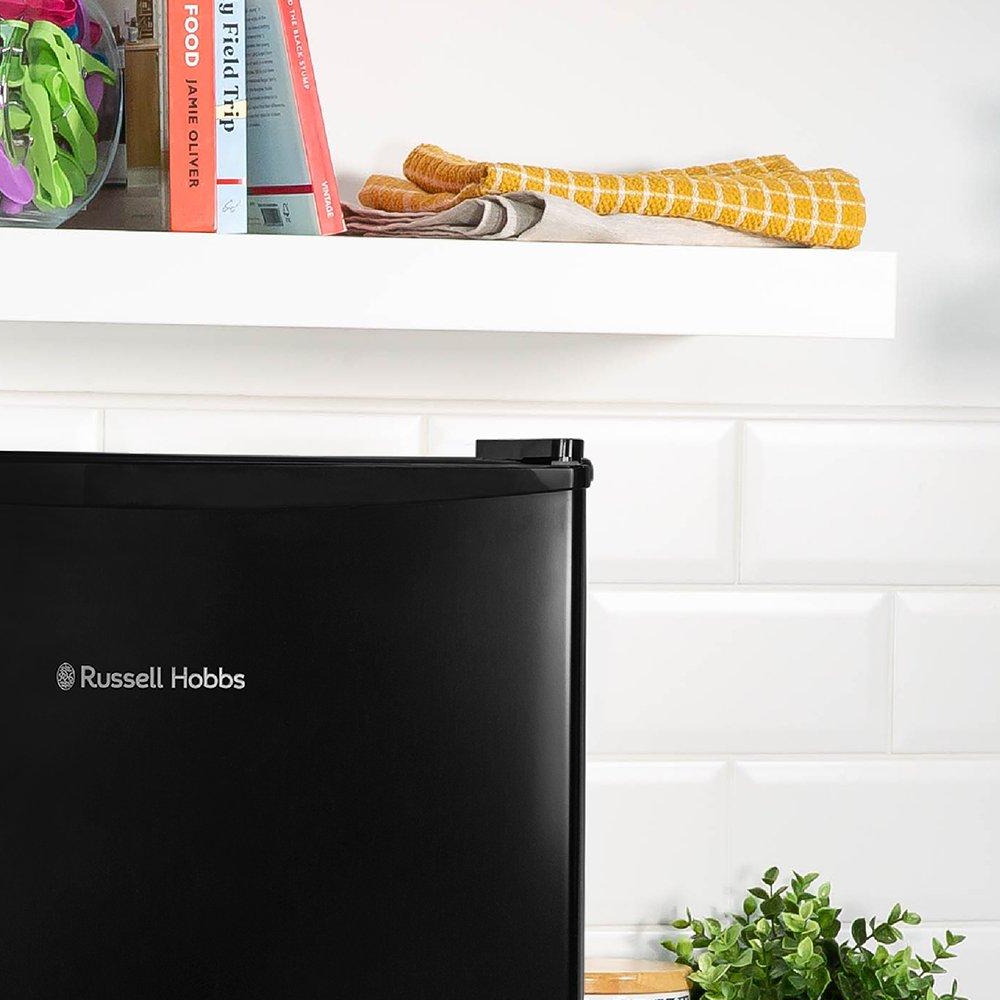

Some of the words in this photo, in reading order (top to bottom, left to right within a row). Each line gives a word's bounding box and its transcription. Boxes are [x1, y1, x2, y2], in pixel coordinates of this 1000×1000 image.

[184, 4, 199, 67] FOOD
[290, 9, 298, 26] THE
[223, 23, 239, 78] Field
[293, 29, 304, 58] BLACK
[298, 60, 310, 90] STUMP
[186, 79, 198, 124] JAMIE
[219, 85, 239, 132] Trip
[188, 130, 199, 188] OLIVER
[322, 181, 335, 219] VINTAGE
[80, 665, 164, 689] Russell
[171, 666, 246, 690] Hobbs
